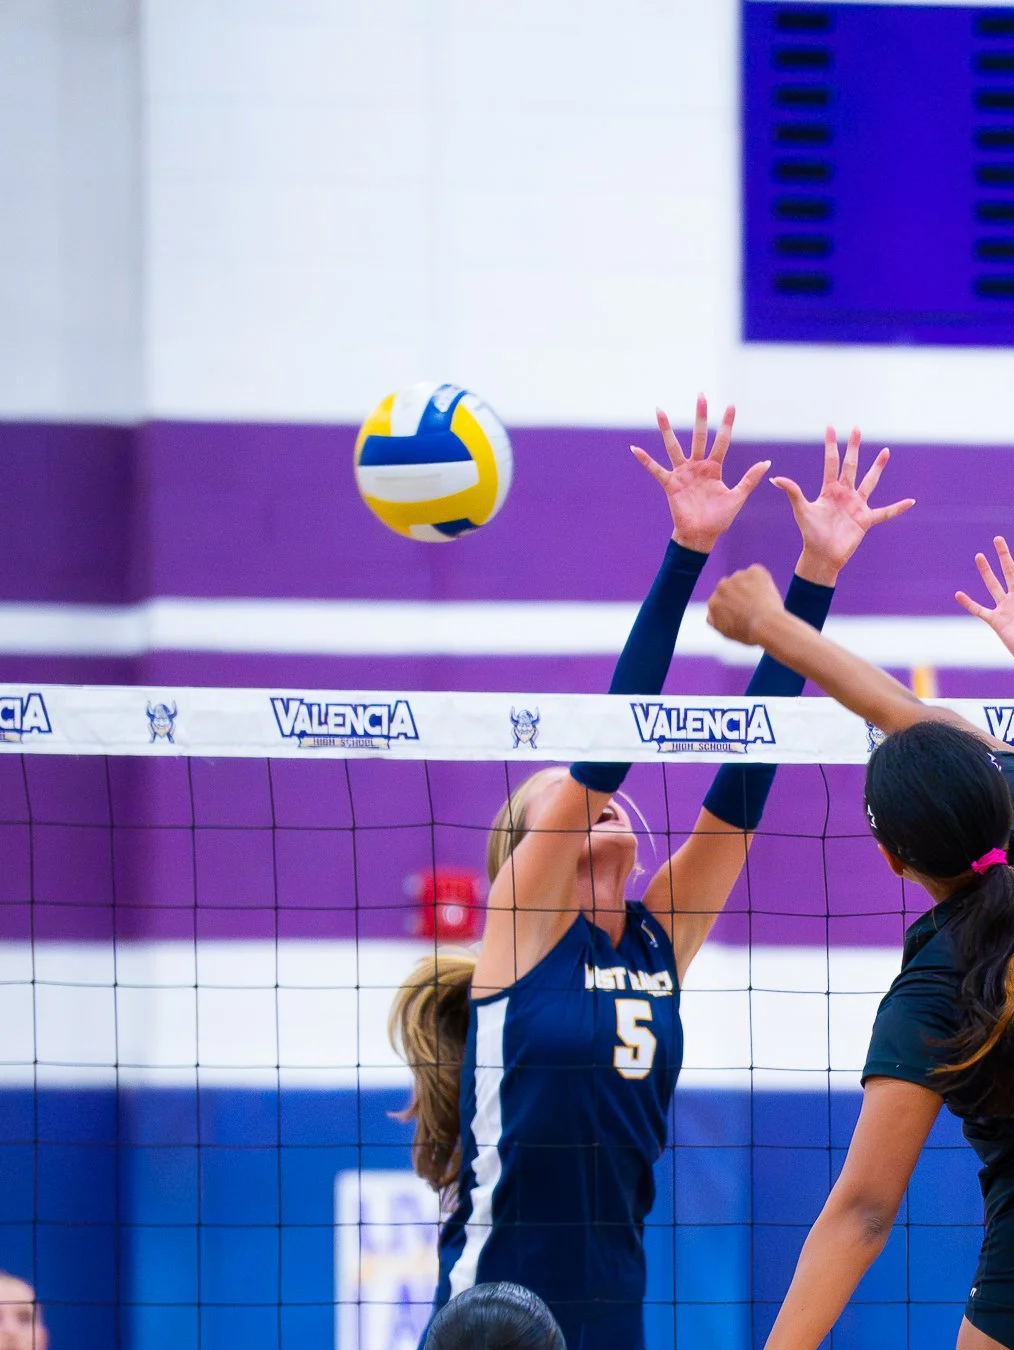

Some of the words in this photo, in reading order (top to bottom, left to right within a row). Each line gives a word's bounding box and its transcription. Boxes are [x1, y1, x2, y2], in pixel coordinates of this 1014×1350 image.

[270, 697, 419, 740] VALENCIA
[630, 703, 776, 744] VALENCIA
[672, 743, 694, 751] HIGH
[699, 743, 731, 751] SCHOOL
[613, 998, 657, 1080] 5
